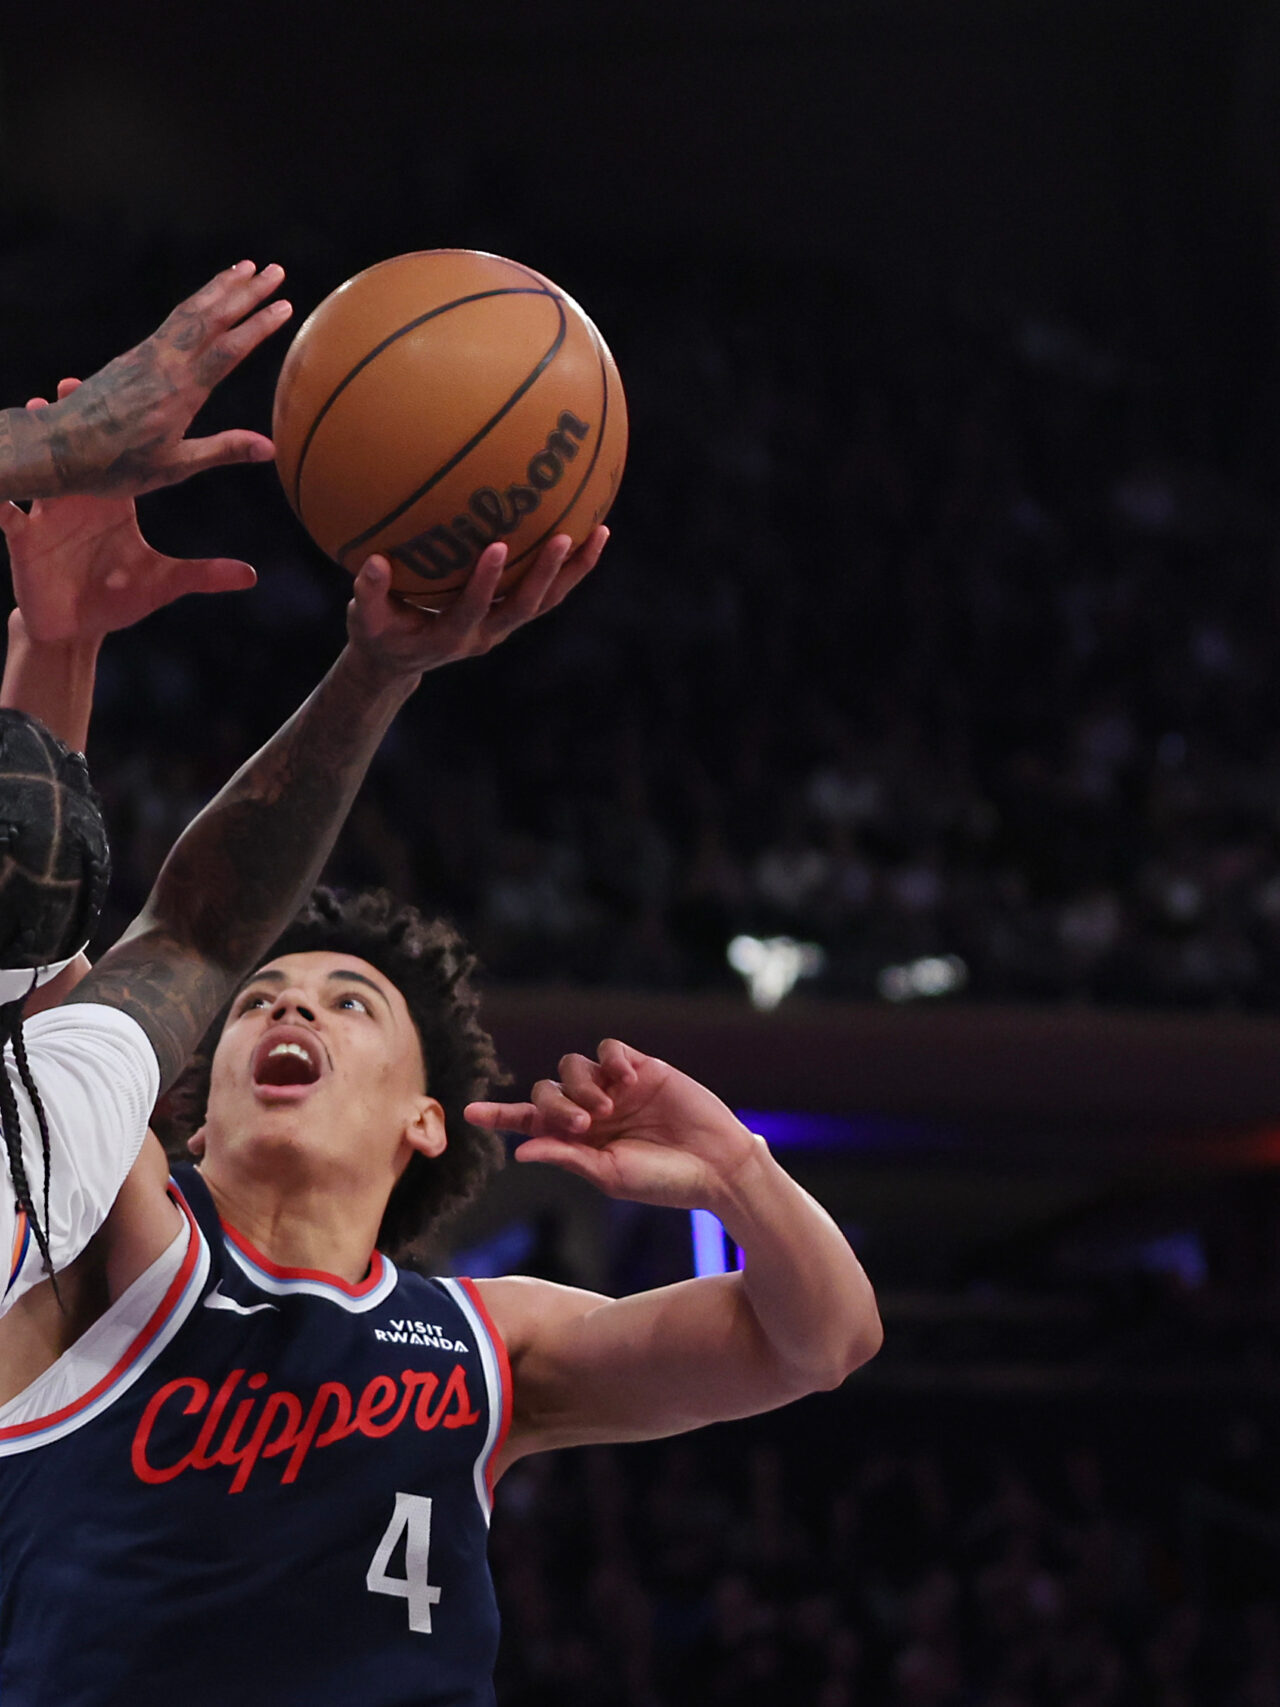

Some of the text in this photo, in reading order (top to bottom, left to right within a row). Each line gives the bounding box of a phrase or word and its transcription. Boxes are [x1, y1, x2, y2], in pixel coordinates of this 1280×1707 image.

[386, 409, 590, 581] Wilson
[374, 1328, 470, 1353] RWANDA
[389, 1319, 443, 1337] VISIT
[131, 1364, 480, 1495] Clippers
[366, 1491, 442, 1634] 4
